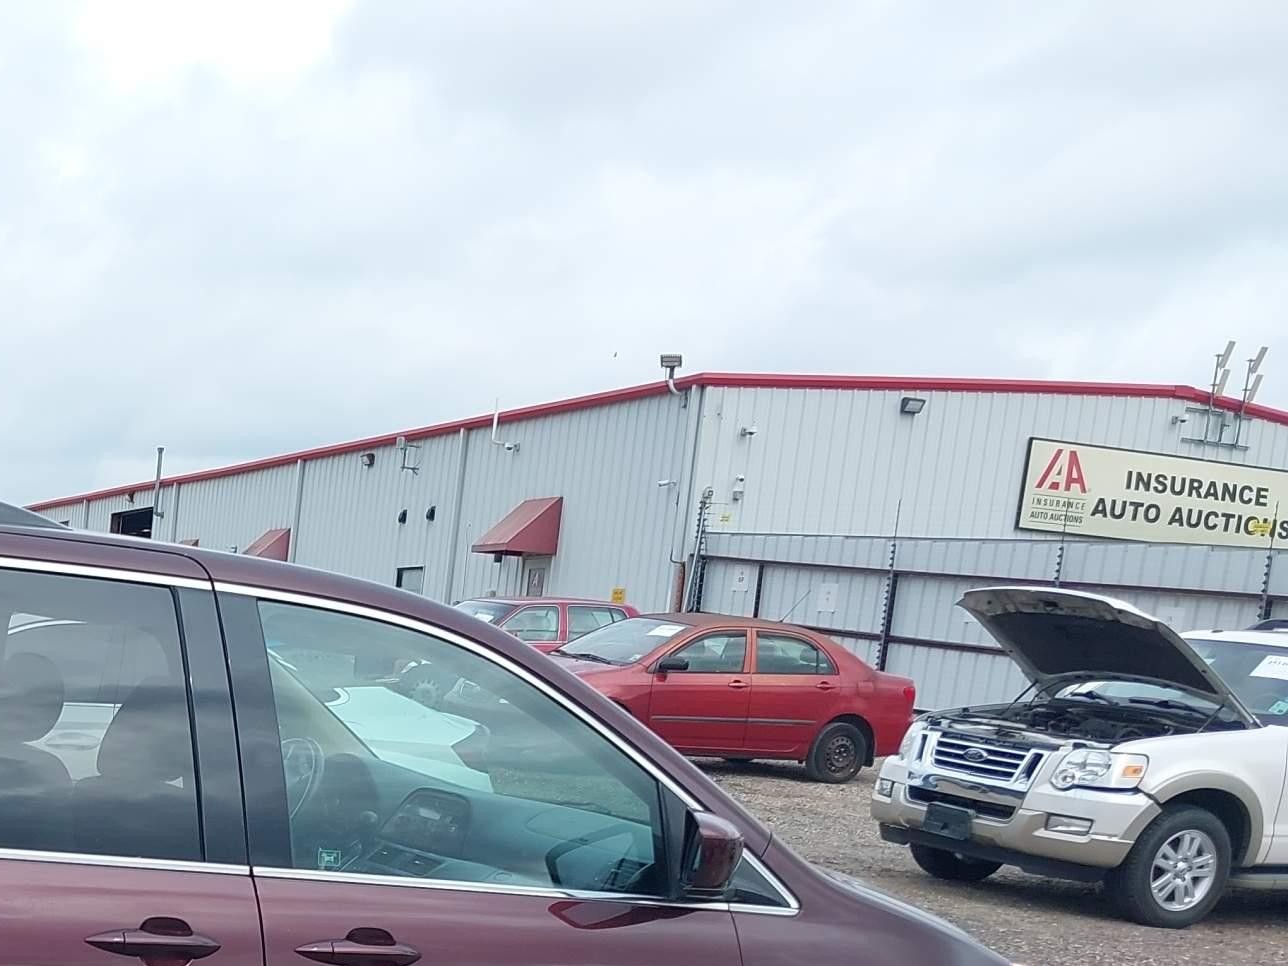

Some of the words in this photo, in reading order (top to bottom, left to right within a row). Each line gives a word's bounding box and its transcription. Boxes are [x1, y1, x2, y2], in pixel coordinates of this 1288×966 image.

[1125, 470, 1269, 507] INSURANCE
[1031, 497, 1087, 511] INSURANCE
[1090, 497, 1161, 523] AUTO
[1029, 511, 1049, 521] AUTO
[1049, 512, 1084, 524] AUCTIONS
